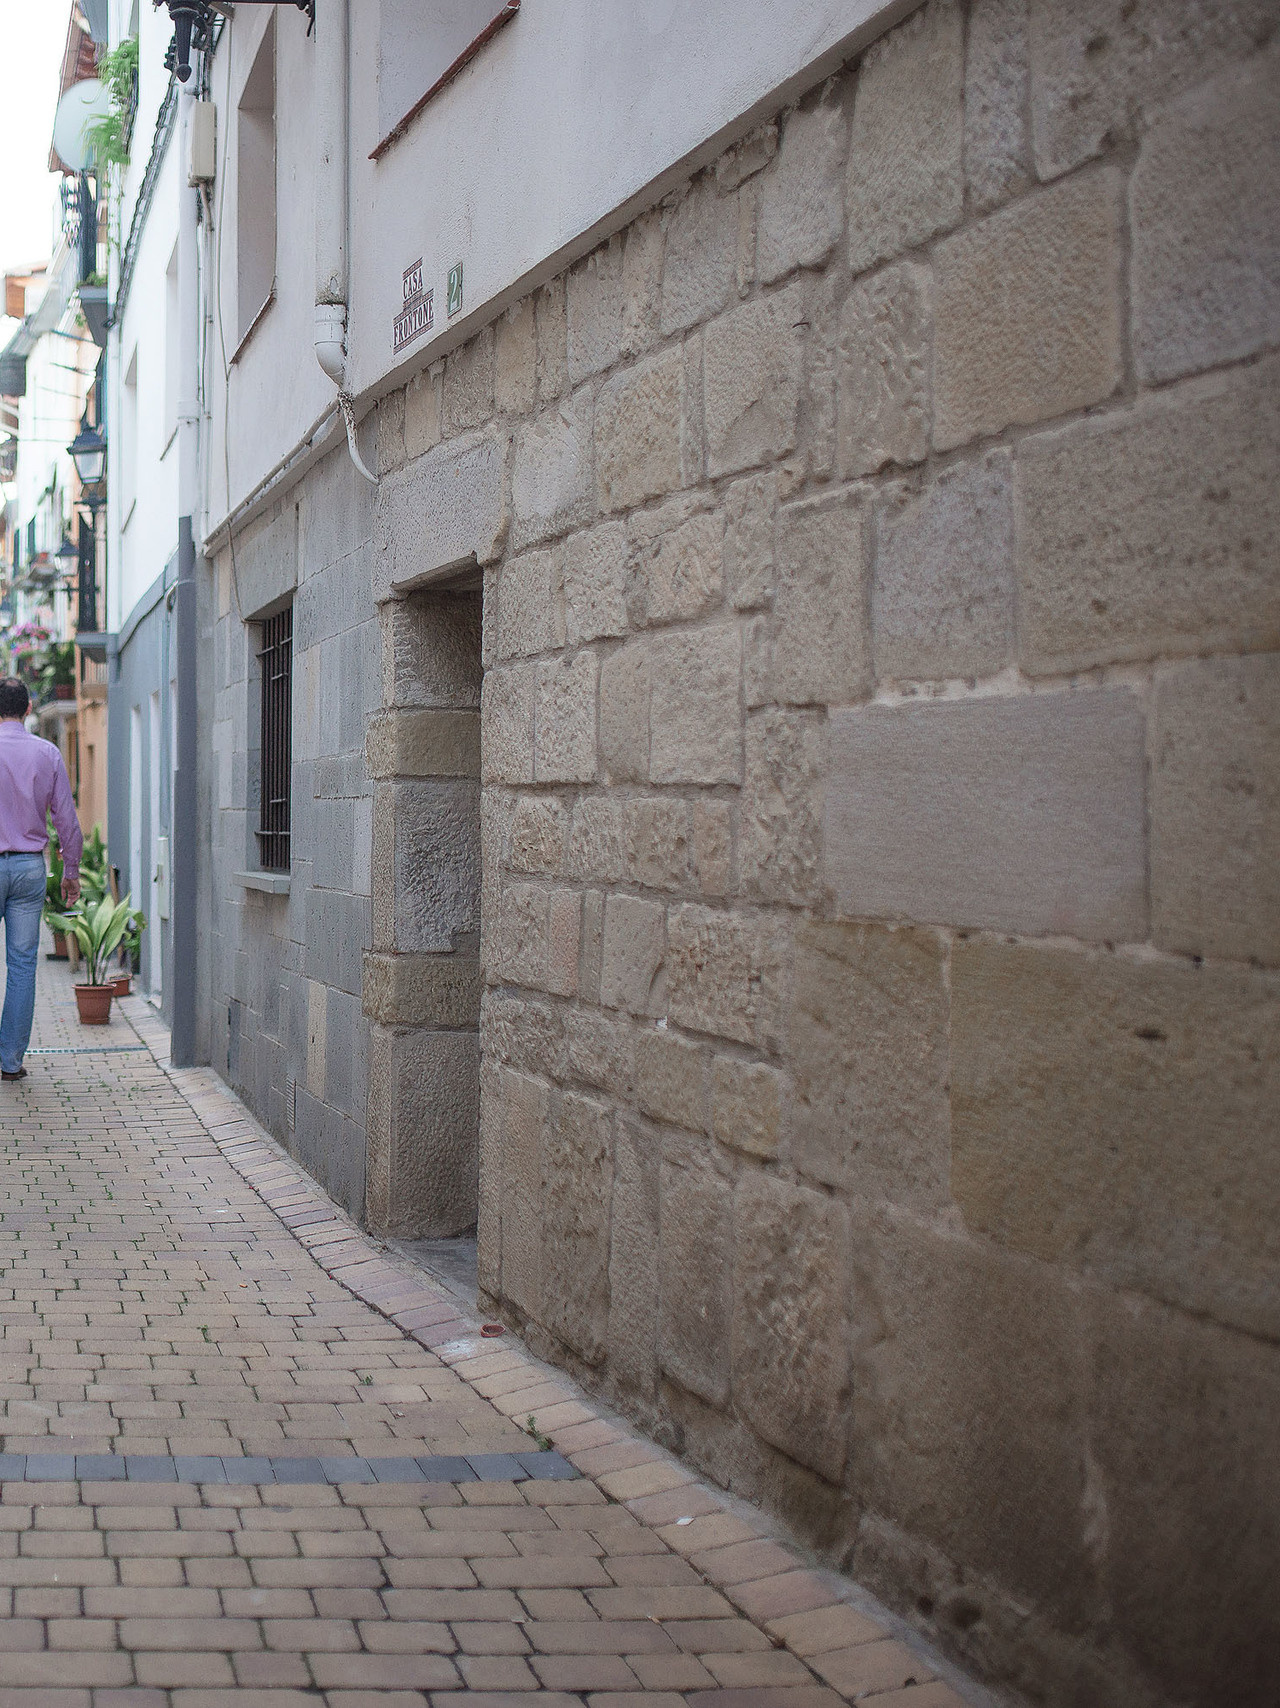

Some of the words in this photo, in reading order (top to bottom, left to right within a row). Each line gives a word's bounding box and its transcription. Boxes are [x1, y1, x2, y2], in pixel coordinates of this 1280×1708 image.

[403, 268, 423, 299] CASA
[449, 270, 458, 311] 2
[393, 298, 434, 346] FRONTONE
